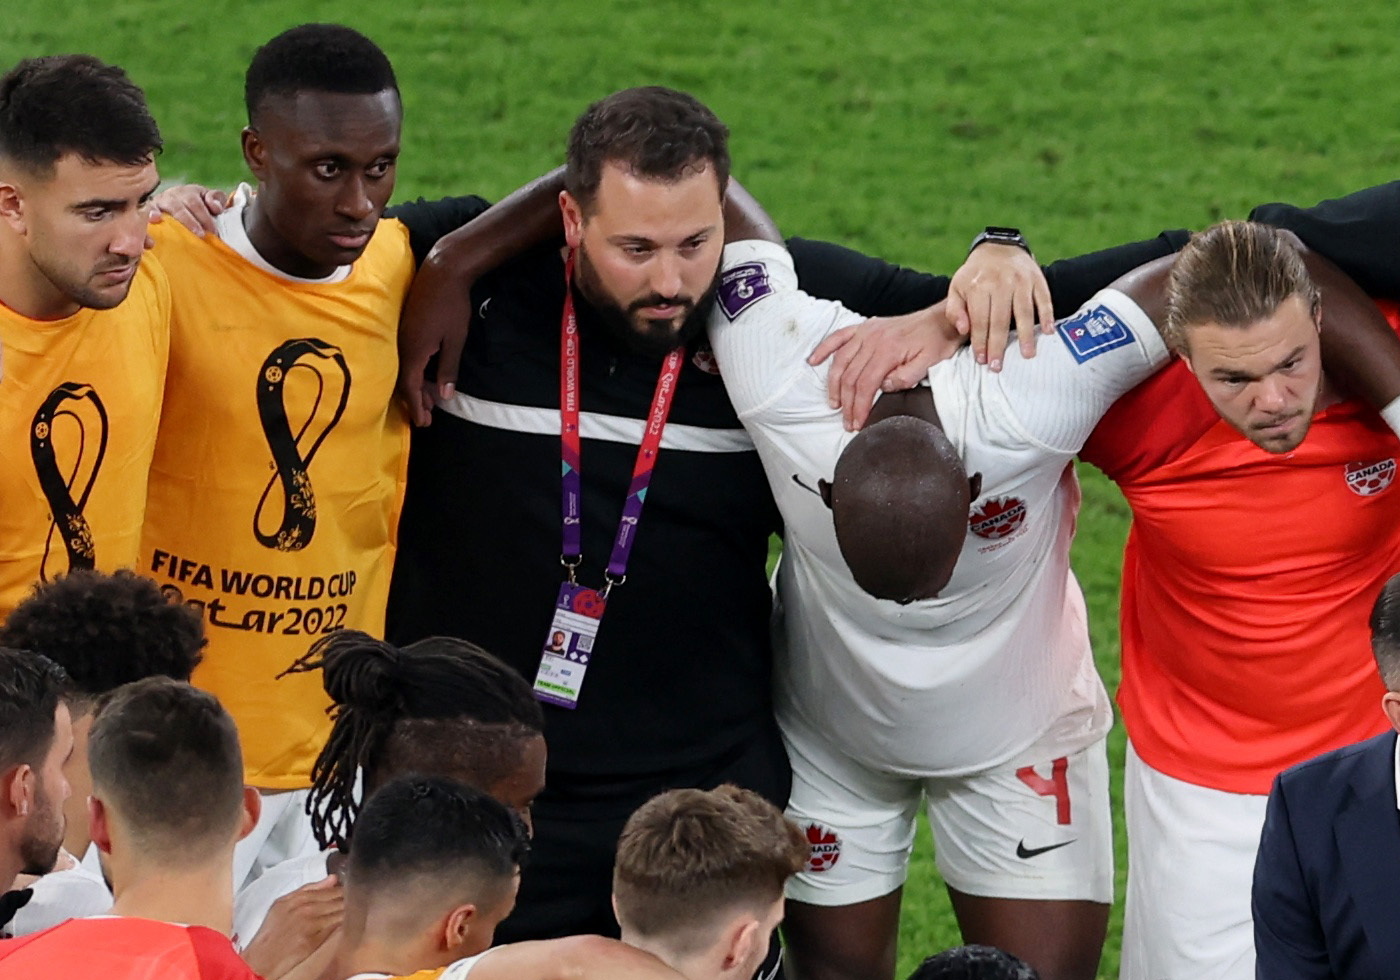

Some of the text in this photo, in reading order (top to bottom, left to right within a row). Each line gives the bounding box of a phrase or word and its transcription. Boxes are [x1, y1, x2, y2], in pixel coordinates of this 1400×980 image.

[1346, 460, 1394, 482] CANADA
[970, 505, 1025, 532] CANADA
[151, 549, 356, 601] FIFA WORLD CUP
[1015, 756, 1071, 825] 4
